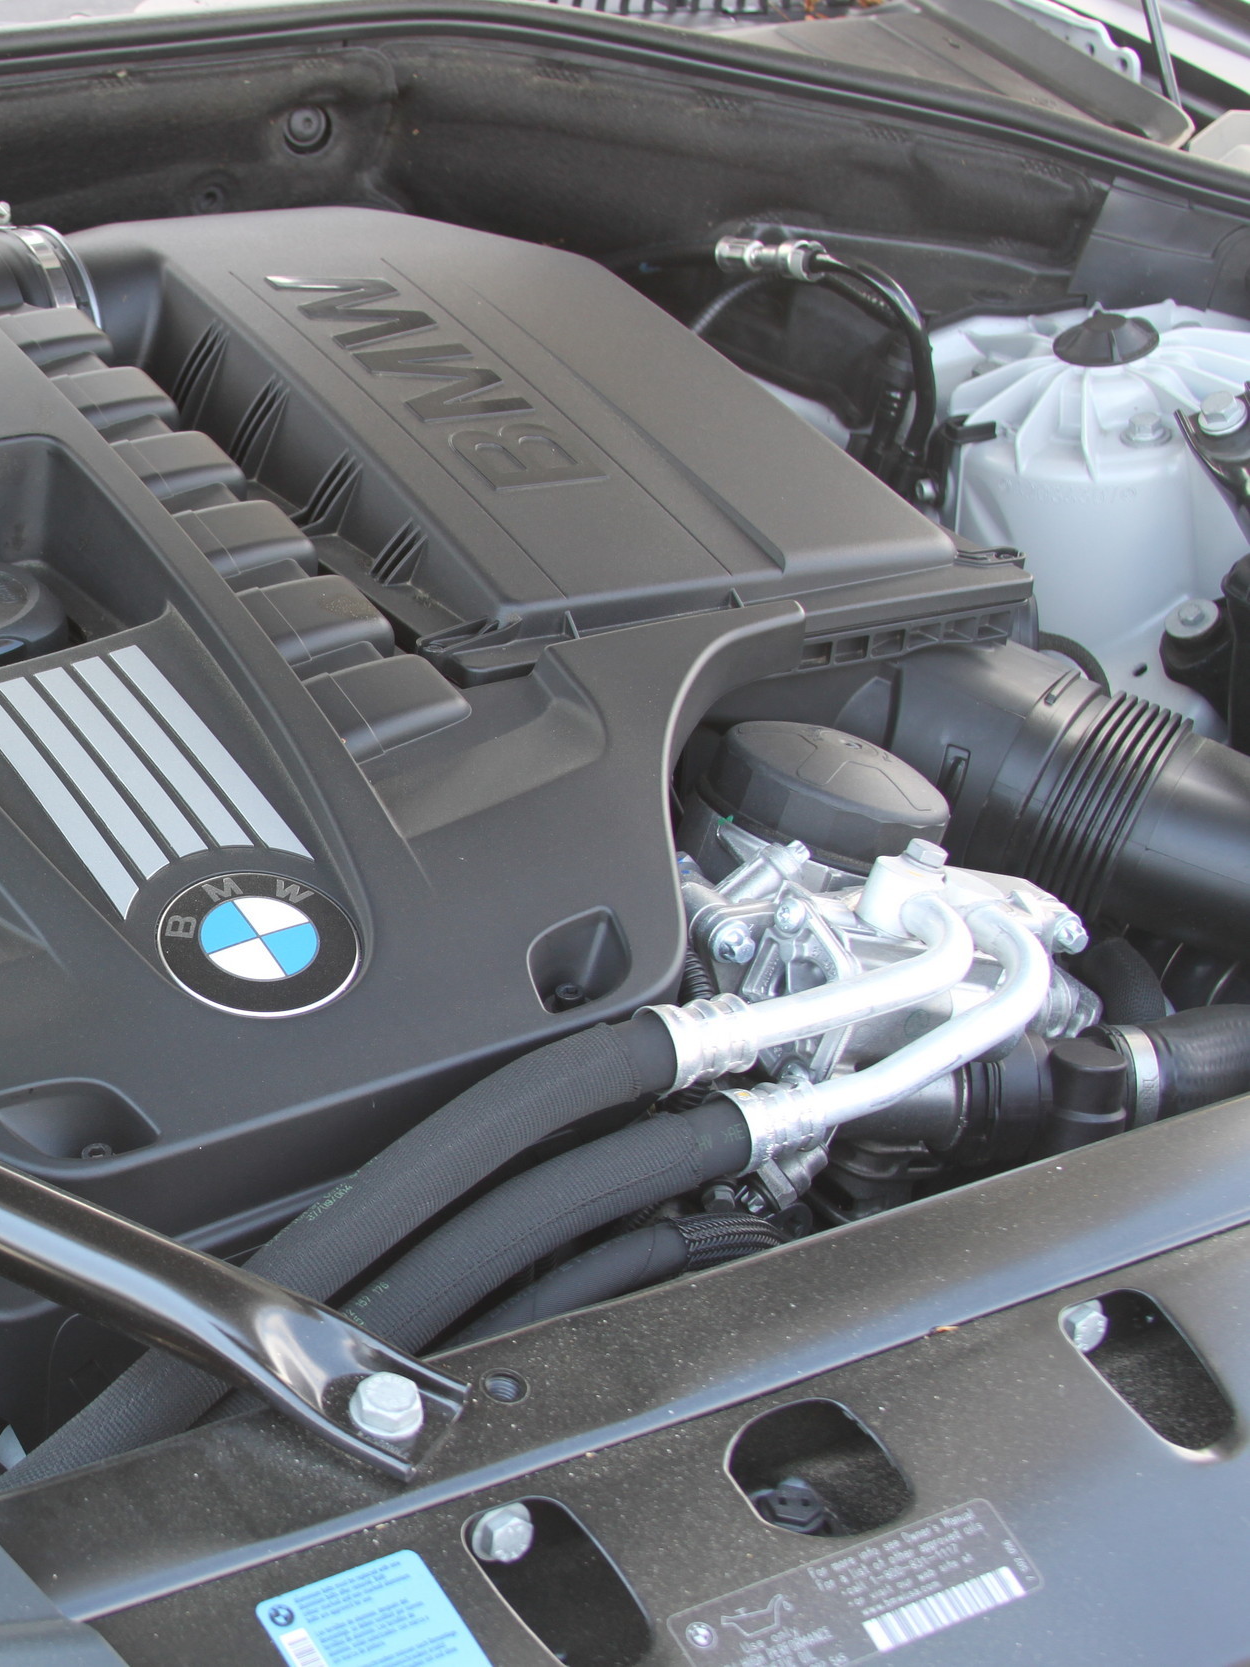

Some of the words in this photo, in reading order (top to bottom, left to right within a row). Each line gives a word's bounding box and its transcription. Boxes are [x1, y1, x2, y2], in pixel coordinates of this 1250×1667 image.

[264, 275, 609, 491] BMW
[164, 877, 314, 939] BMW
[831, 1556, 857, 1571] more
[739, 1640, 766, 1653] Use
[770, 1626, 801, 1642] only
